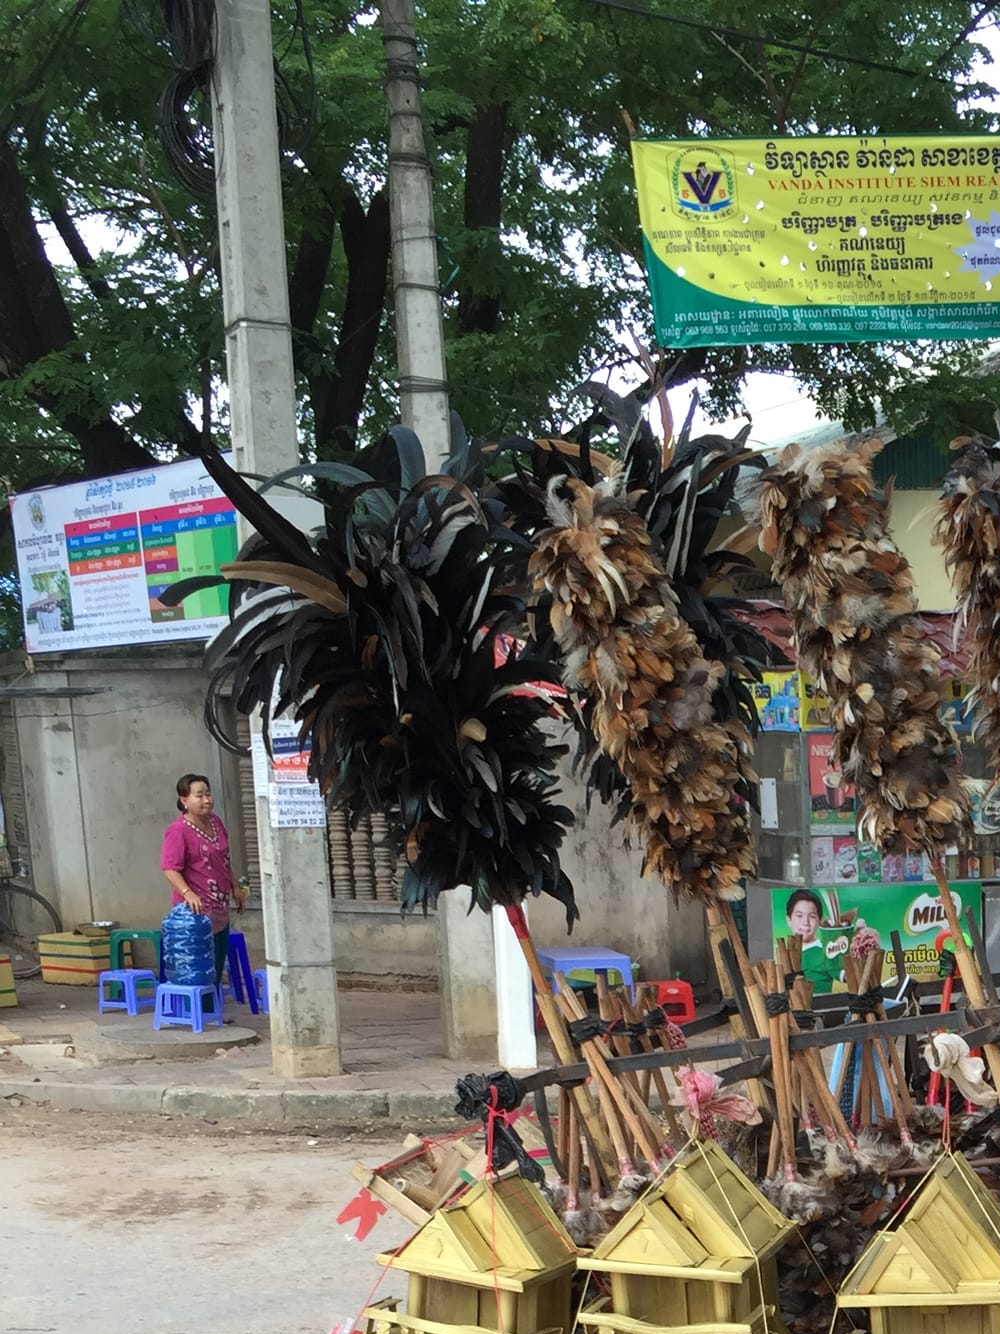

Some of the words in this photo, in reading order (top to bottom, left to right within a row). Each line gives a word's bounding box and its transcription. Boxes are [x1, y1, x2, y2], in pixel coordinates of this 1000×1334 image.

[765, 142, 849, 178] វិទ្យាស្ថាន
[768, 179, 825, 191] VANDA
[828, 177, 916, 190] INSTITUTE
[921, 175, 961, 188] SIEM
[781, 211, 857, 234] បរិញ្ញាបត្រ
[870, 209, 963, 232] បរិញ្ញាបត្ររង
[839, 236, 905, 255] គណនេយ្យ
[870, 255, 934, 272] និងធនាគារ
[763, 322, 776, 332] 017
[827, 942, 848, 954] MILO
